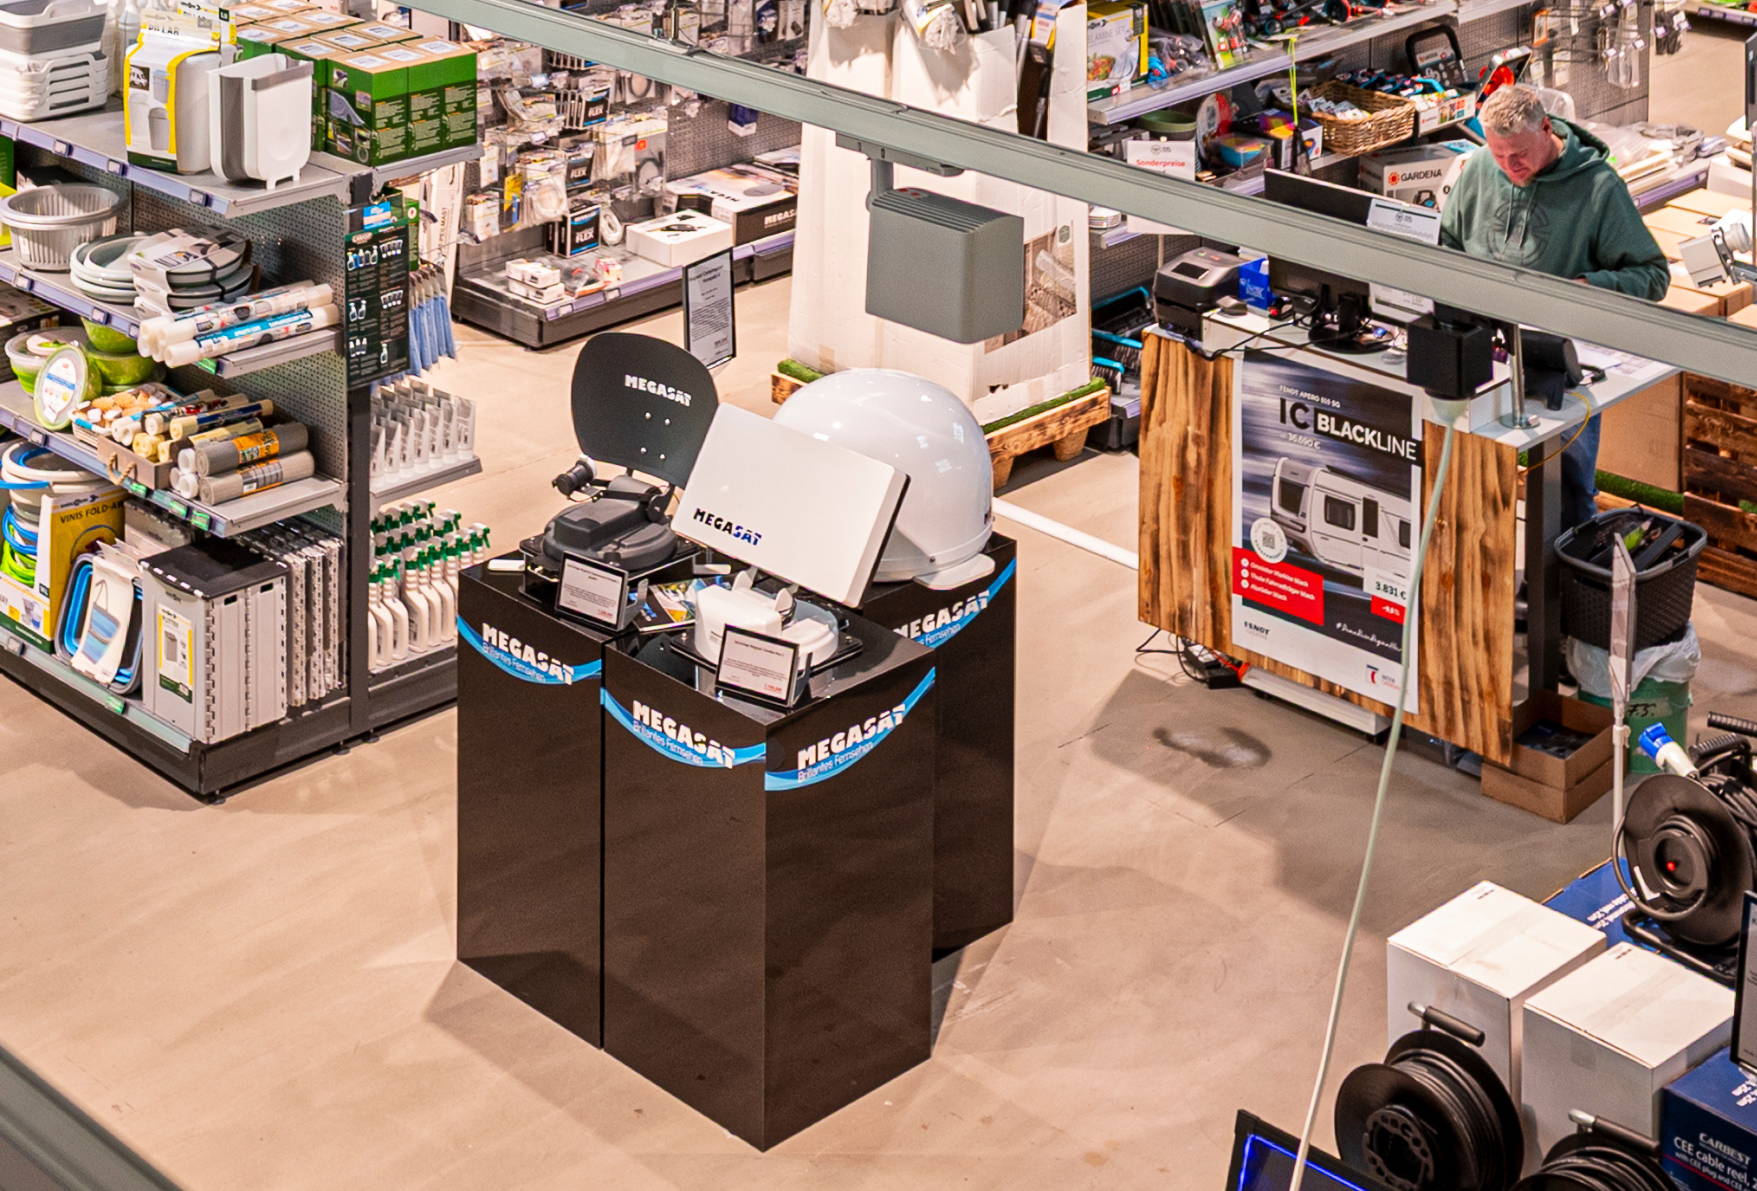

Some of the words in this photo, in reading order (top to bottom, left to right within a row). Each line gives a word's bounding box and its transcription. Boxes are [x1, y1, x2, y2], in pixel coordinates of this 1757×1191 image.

[1136, 158, 1186, 169] Sonderpreise
[1400, 168, 1443, 185] GARDENA
[624, 373, 692, 408] MEGASAT
[1278, 396, 1310, 431] IC
[1316, 411, 1418, 461] BLACKLINE
[59, 510, 84, 524] VINIS
[84, 501, 124, 518] FOLD-AW
[692, 507, 761, 546] MEGASAT
[1243, 620, 1270, 636] FENDT
[482, 622, 575, 686] MEGASAT
[632, 699, 736, 770] MEGASAT
[797, 703, 906, 771] MEGASAT
[797, 757, 833, 784] Brillantes
[834, 741, 874, 771] Fernsehen
[1673, 1136, 1694, 1155] CEE
[1695, 1150, 1725, 1172] cable
[1727, 1165, 1751, 1187] reel,
[1698, 1132, 1752, 1166] CARBEST
[1702, 1163, 1718, 1180] plug
